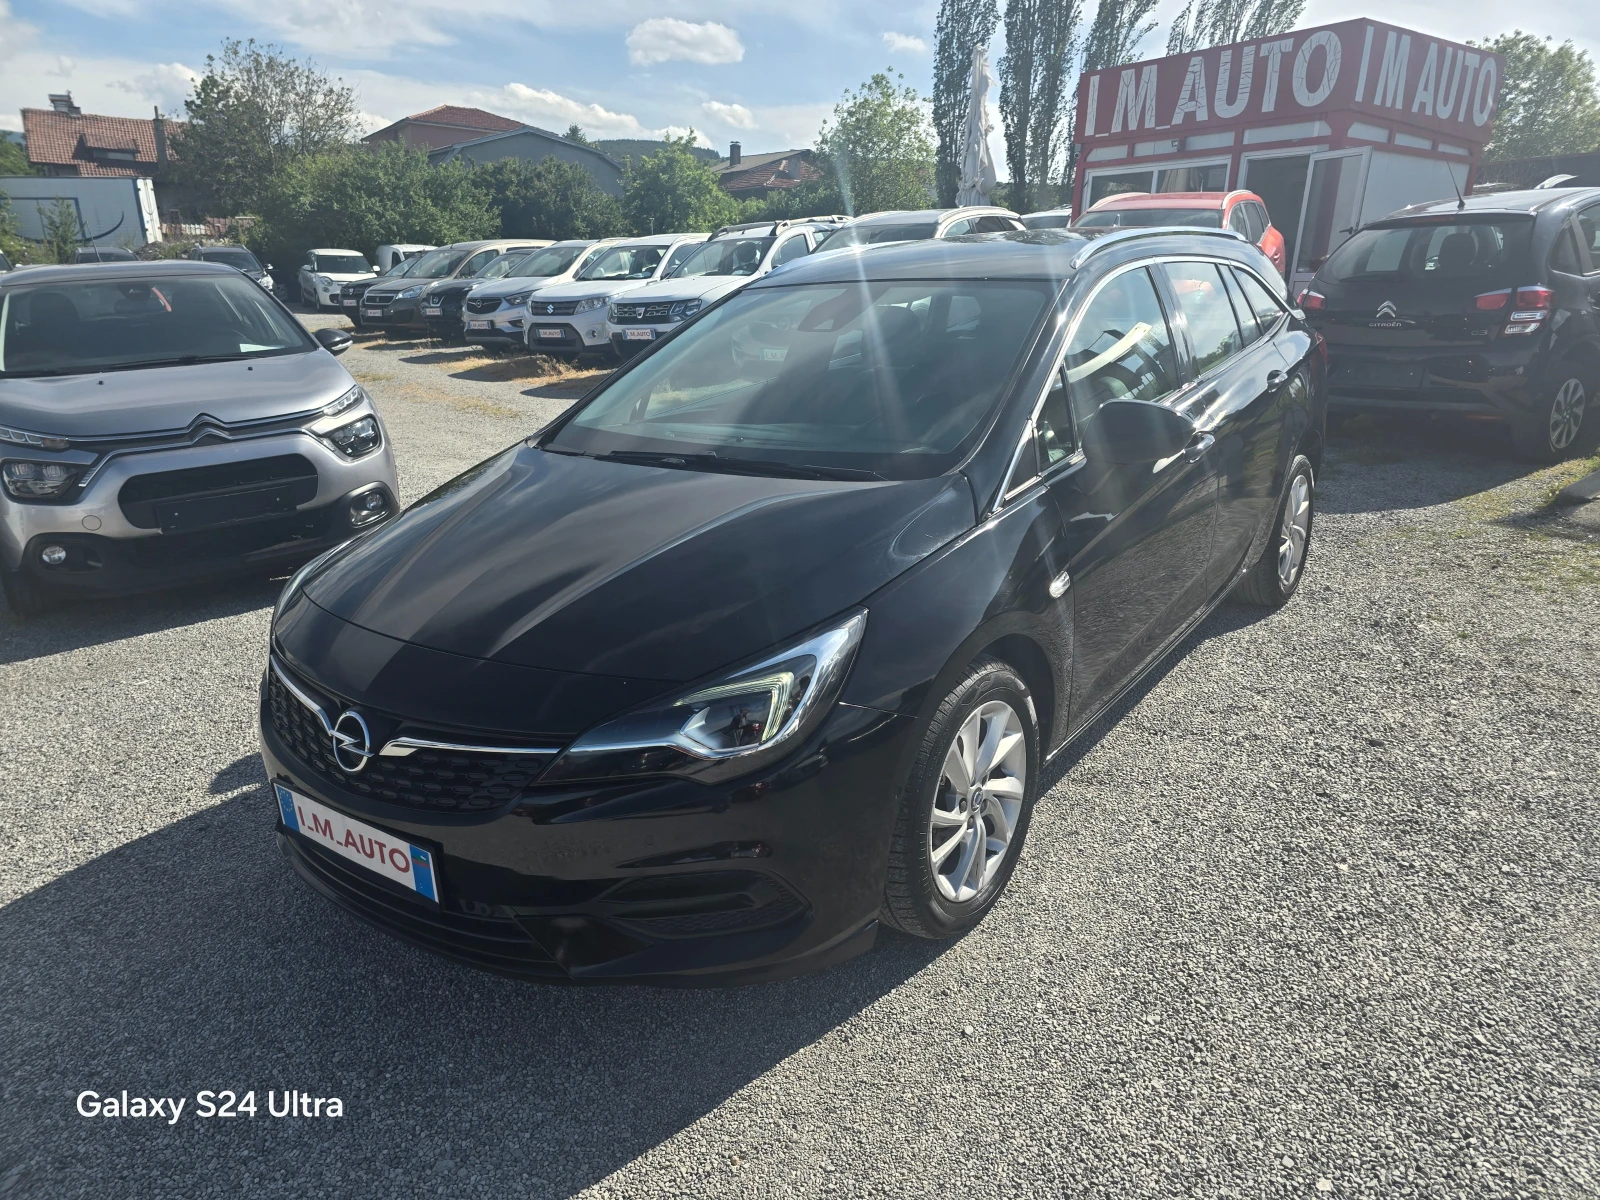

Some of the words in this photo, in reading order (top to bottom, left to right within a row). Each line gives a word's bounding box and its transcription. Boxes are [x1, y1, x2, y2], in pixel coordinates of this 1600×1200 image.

[1355, 25, 1374, 103] I
[1373, 30, 1412, 110] M
[1411, 42, 1497, 127] AUTO
